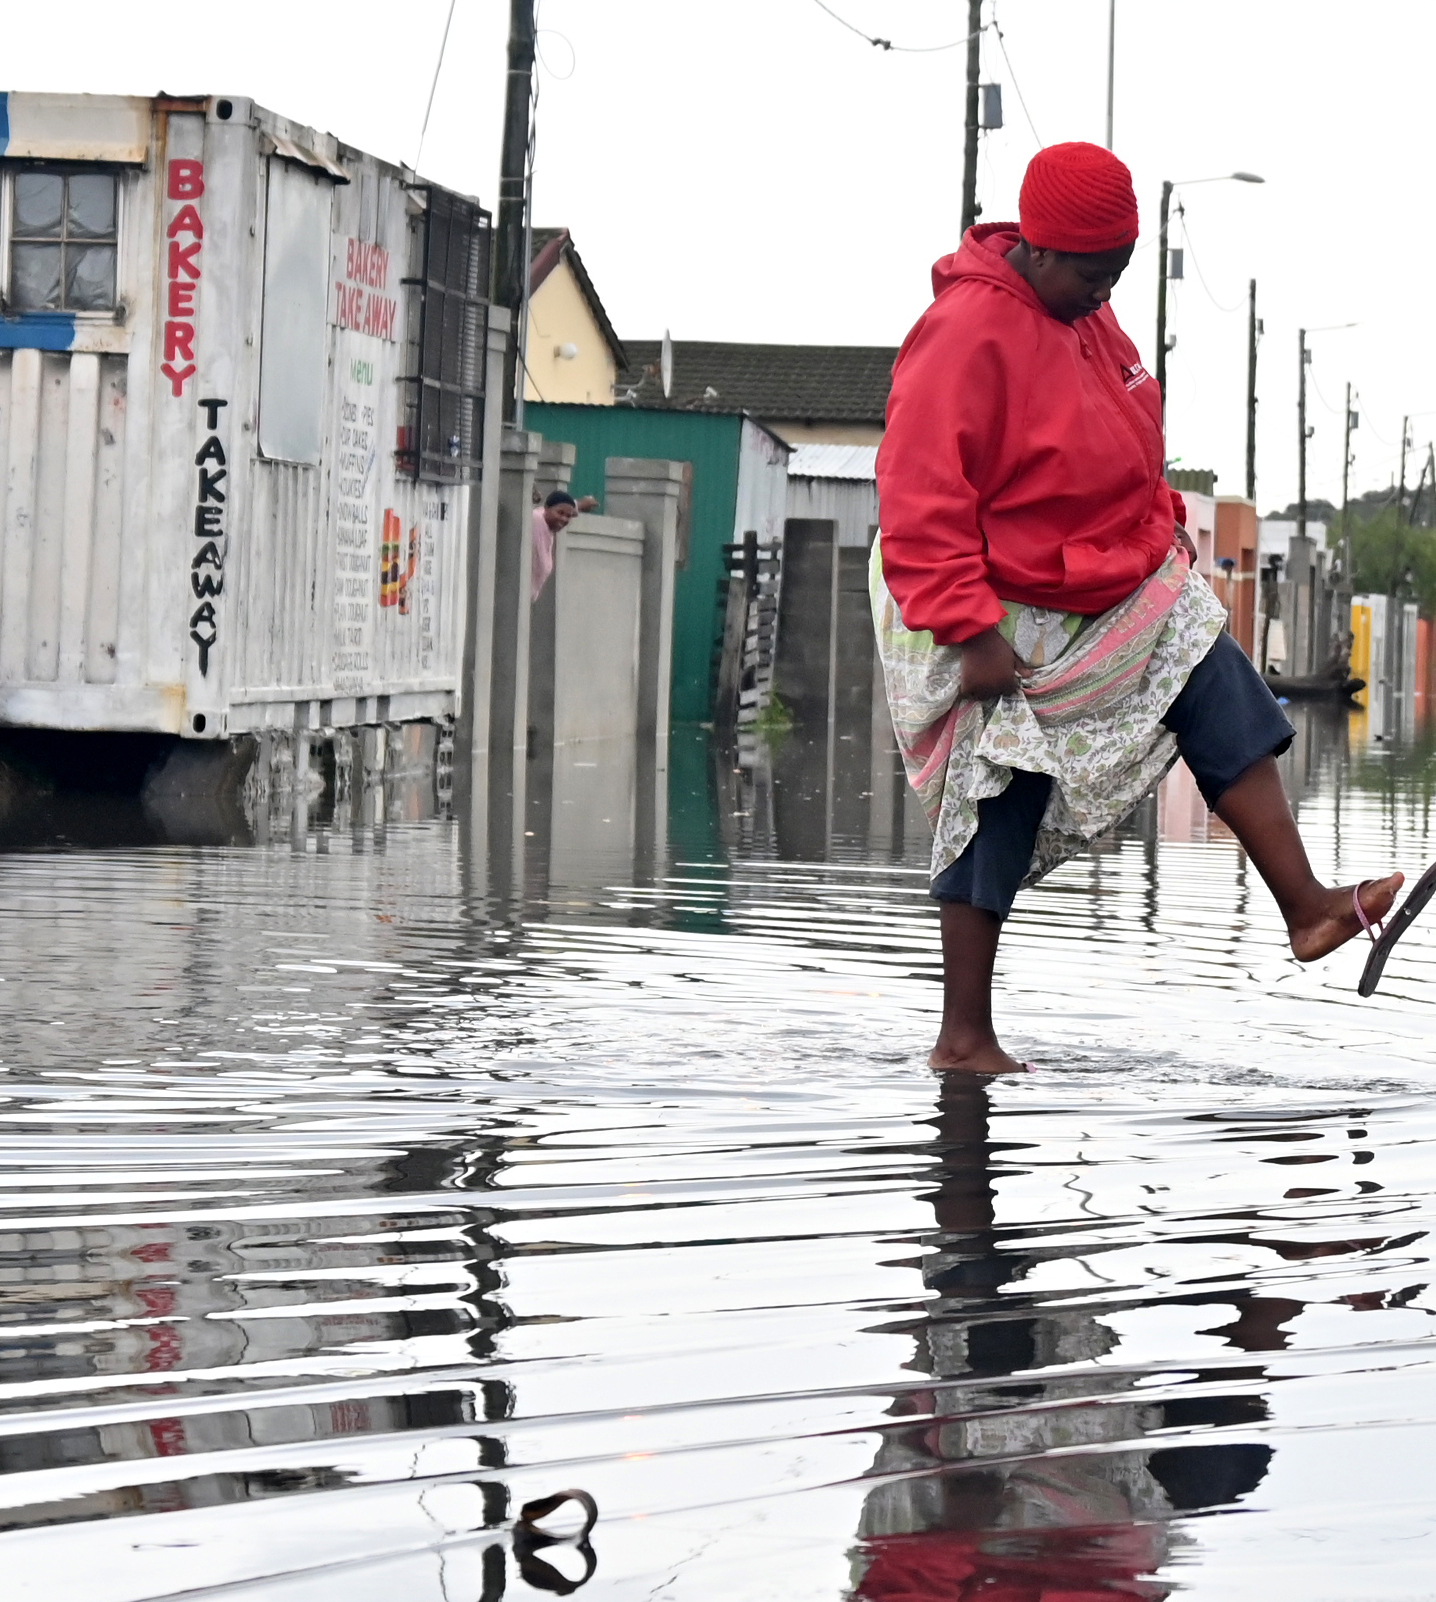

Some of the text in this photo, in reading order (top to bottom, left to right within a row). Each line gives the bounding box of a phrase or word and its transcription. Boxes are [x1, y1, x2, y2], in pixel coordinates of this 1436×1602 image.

[160, 159, 204, 397] BAKERY
[346, 237, 389, 291] BAKERY
[335, 281, 396, 340] TAKE AWAY
